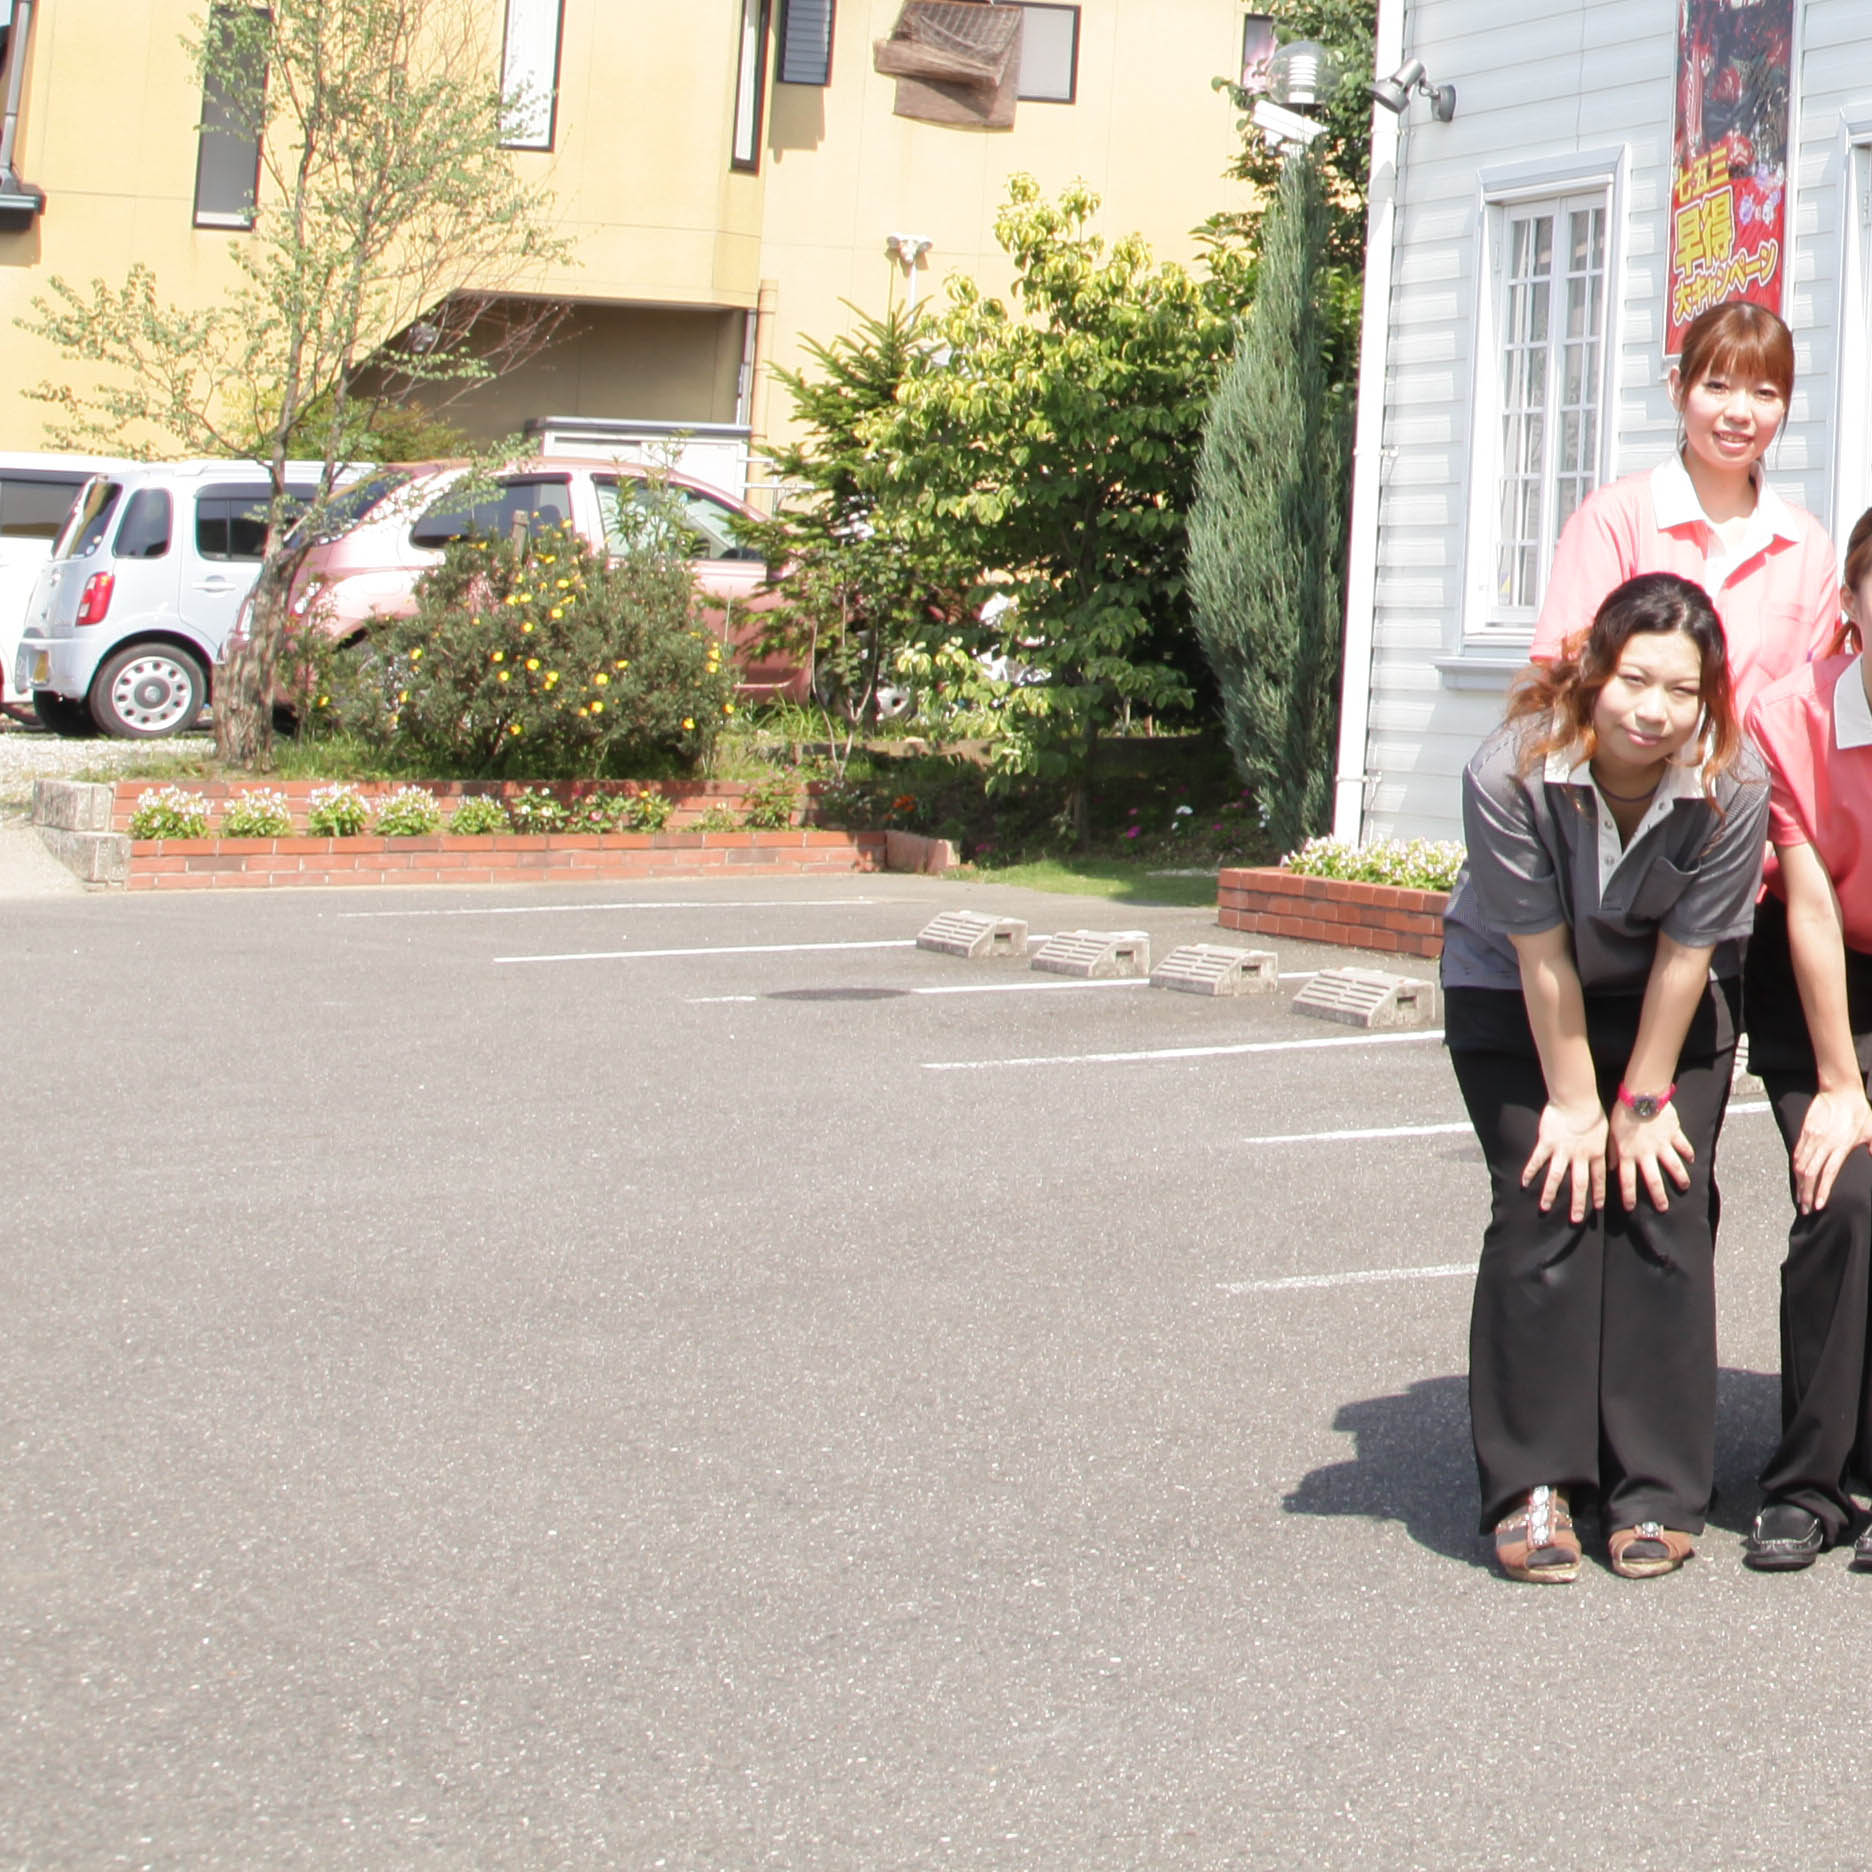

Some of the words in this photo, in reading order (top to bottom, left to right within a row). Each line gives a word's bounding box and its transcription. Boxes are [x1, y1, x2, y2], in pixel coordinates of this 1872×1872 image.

[1675, 148, 1730, 202] 七五三
[1676, 191, 1733, 277] 早得
[1674, 242, 1777, 321] 大キャンペーン
